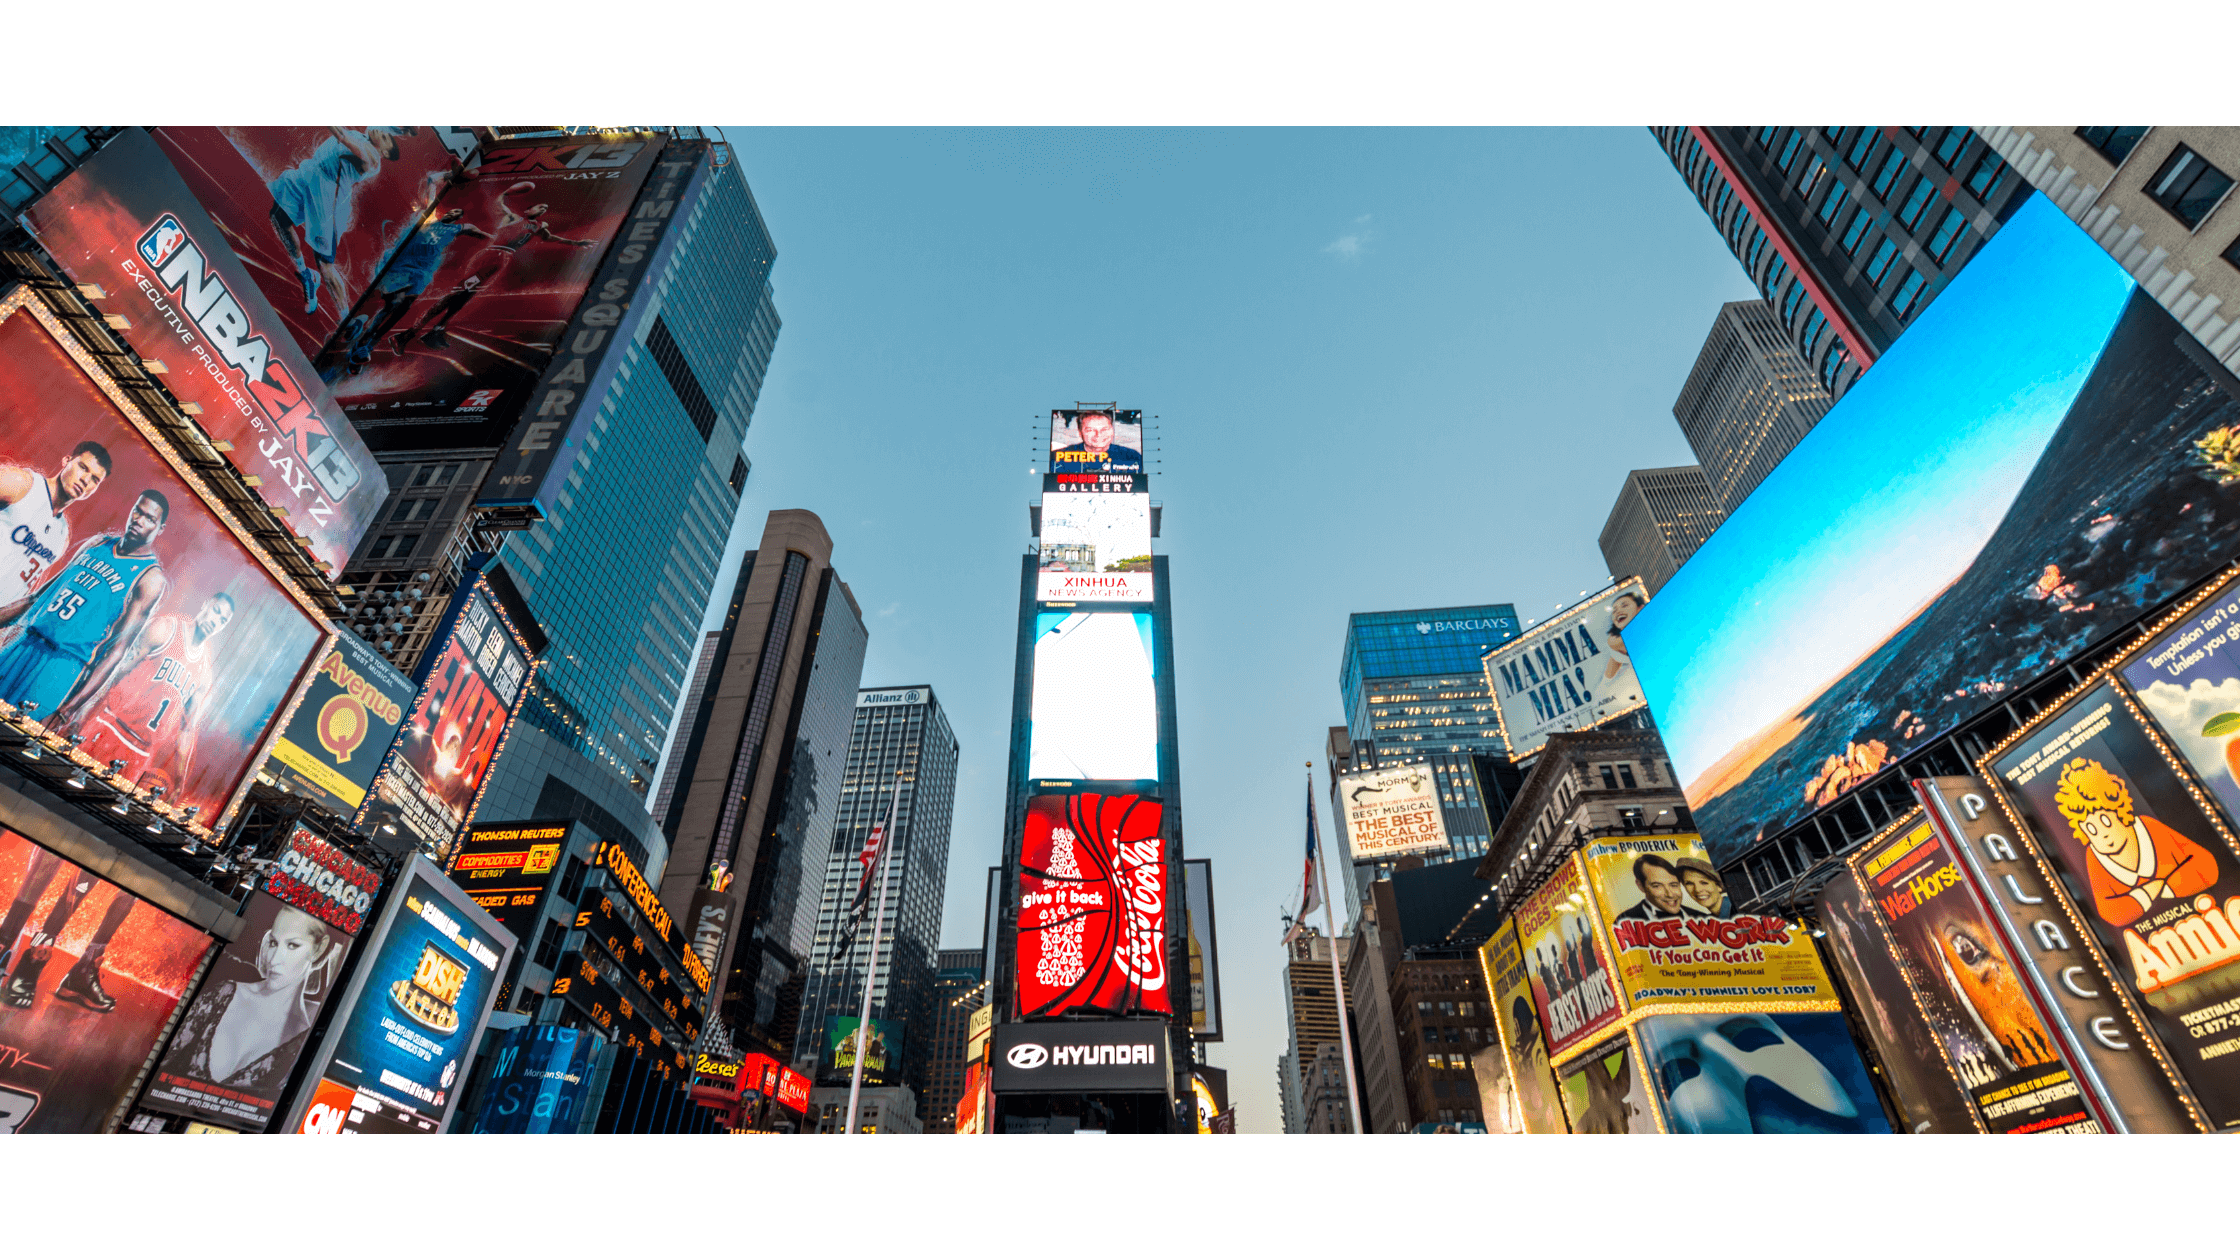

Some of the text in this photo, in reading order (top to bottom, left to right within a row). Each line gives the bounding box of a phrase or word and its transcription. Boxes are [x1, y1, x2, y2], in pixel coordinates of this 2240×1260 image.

[564, 172, 603, 180] JAY
[607, 171, 621, 179] Z
[517, 161, 692, 451] TIMES SQUARE
[121, 259, 338, 527] EXECUTIVE PRODUCED BY JAY Z
[468, 390, 495, 406] 2K
[1055, 452, 1112, 462] PETER P.
[499, 475, 533, 485] NYC
[1059, 484, 1133, 492] GALLERY
[1099, 475, 1133, 483] XINHUA
[74, 571, 101, 591] CITY
[1064, 577, 1128, 587] XINHUA
[47, 588, 87, 621] 35
[1049, 589, 1142, 597] NEWS AGENCY
[469, 599, 490, 634] RICKY
[1435, 618, 1509, 632] BARCLAYS
[338, 630, 375, 662] BROADWAY'S
[457, 615, 482, 656] MARTIN
[486, 625, 506, 660] ELENA
[2146, 603, 2239, 669] Temptation isn't a
[1498, 623, 1601, 699] MAMMA
[2167, 633, 2227, 676] Unless you
[351, 650, 393, 688] BEST MUSICAL
[320, 651, 401, 726] Avenue
[863, 693, 903, 704] Allianz
[1528, 666, 1592, 726] MIA!
[148, 699, 170, 732] 1
[317, 694, 368, 764] Q
[2005, 702, 2113, 781] THE TONY AWARD-WINNING
[2016, 717, 2111, 786] BEST MUSICAL RETURNS!
[1352, 802, 1433, 819] BEST MUSICAL
[1391, 810, 1434, 827] BEST
[471, 828, 565, 842] THOMSON REUTERS
[1356, 822, 1437, 842] MUSICAL OF
[1358, 841, 1383, 850] THIS
[1619, 839, 1679, 853] BRODERICK
[462, 855, 523, 867] COMMODITIES
[281, 850, 370, 914] CHICAGO
[470, 869, 506, 878] ENERGY
[511, 895, 536, 906] GAS
[608, 844, 672, 942] CONFERENCE CALL
[1022, 890, 1103, 908] give it back
[1519, 861, 1577, 922] THE CROWD
[1523, 905, 1551, 938] GOES
[1959, 792, 2129, 1050] PALACE
[2135, 903, 2193, 935] THE MUSICAL
[1613, 915, 1790, 953] NICE WORK
[1648, 948, 1765, 966] If You Can Get It
[414, 948, 466, 1004] DISH
[1659, 968, 1675, 978] The
[1733, 968, 1765, 977] Musical
[1699, 985, 1816, 997] FUNNIEST LOVE STORY
[396, 981, 458, 1029] NATION
[1547, 984, 1587, 1043] JERSEY
[1580, 966, 1615, 1022] BOYS
[2189, 1026, 2205, 1039] OR
[696, 1054, 739, 1077] Reese's
[1053, 1044, 1155, 1065] HYUNDAI
[524, 1068, 580, 1085] Morgan Stanley
